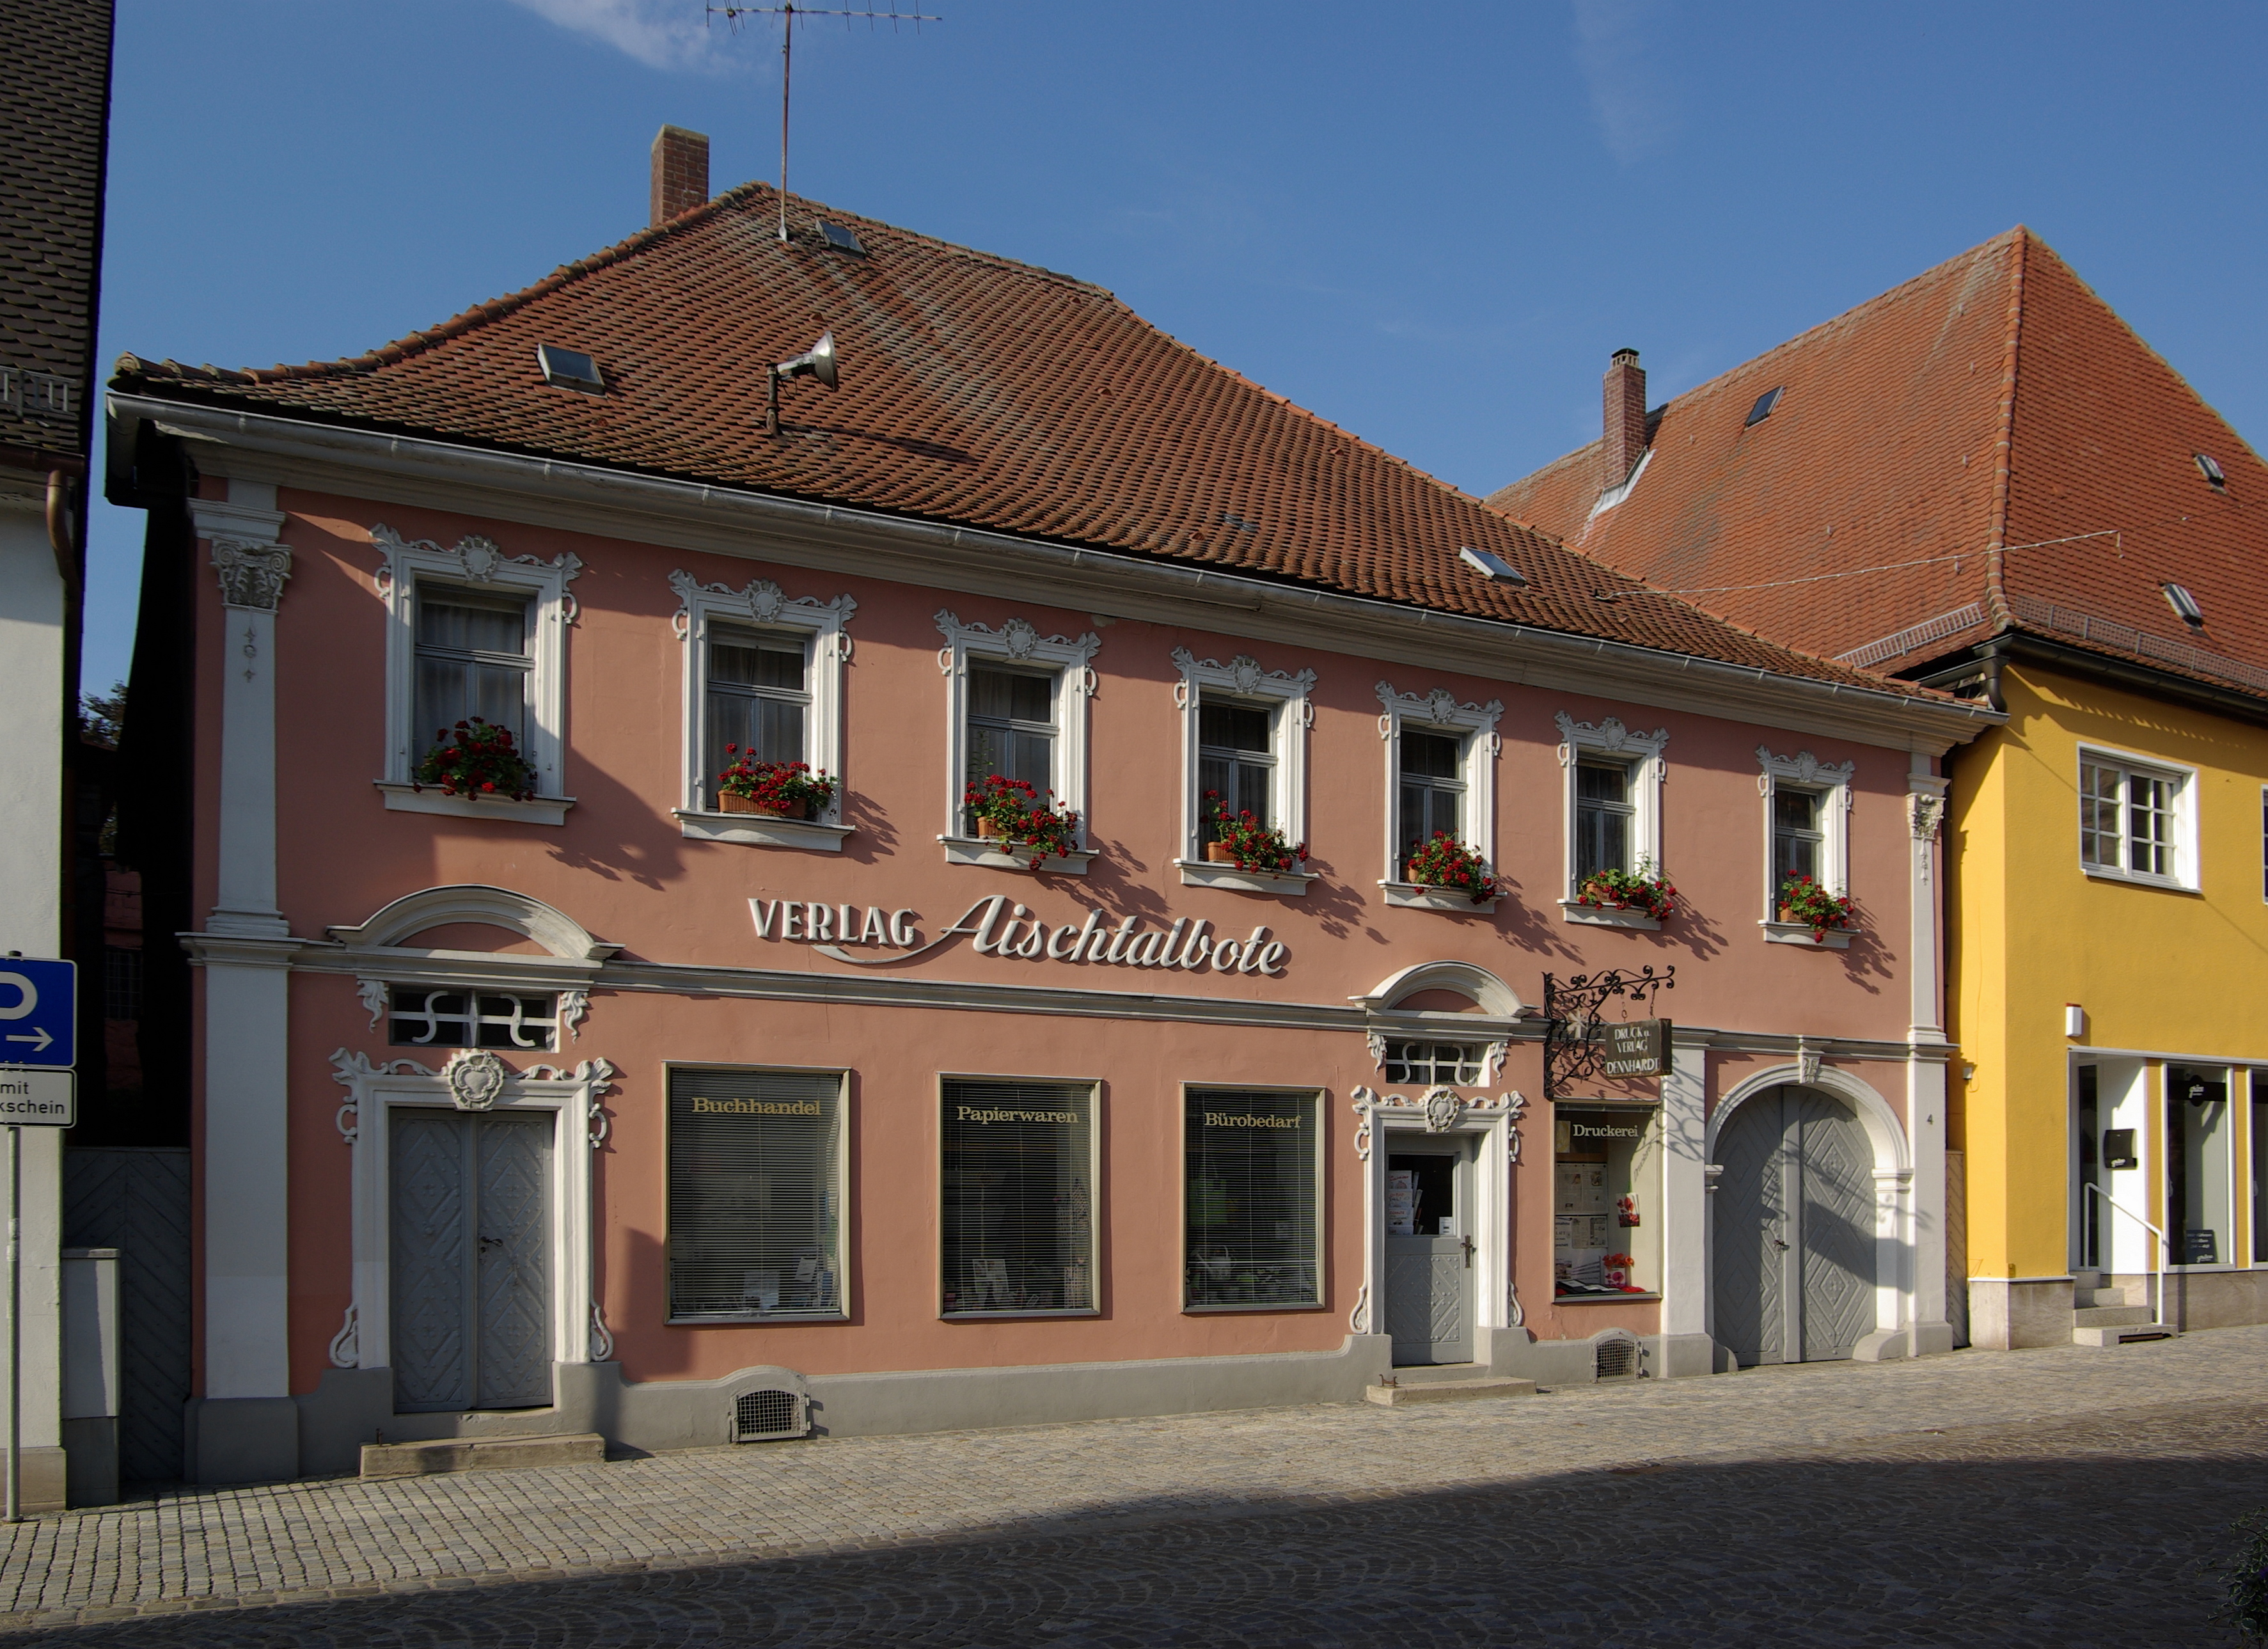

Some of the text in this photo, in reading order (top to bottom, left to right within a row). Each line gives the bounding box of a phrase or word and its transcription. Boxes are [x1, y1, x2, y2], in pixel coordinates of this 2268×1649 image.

[747, 895, 1284, 975] VERLAG Aischtalbote
[1614, 1027, 1642, 1041] DRUCK
[1616, 1039, 1648, 1053] VERLAG
[1607, 1057, 1660, 1075] DENNHARDT
[0, 1081, 29, 1094] mit
[692, 1097, 822, 1116] Buchhandel
[956, 1106, 1079, 1125] Papierwaren
[1204, 1112, 1302, 1128] Bürobedarf
[1927, 1114, 1934, 1125] 4
[1573, 1124, 1639, 1137] Druckerei
